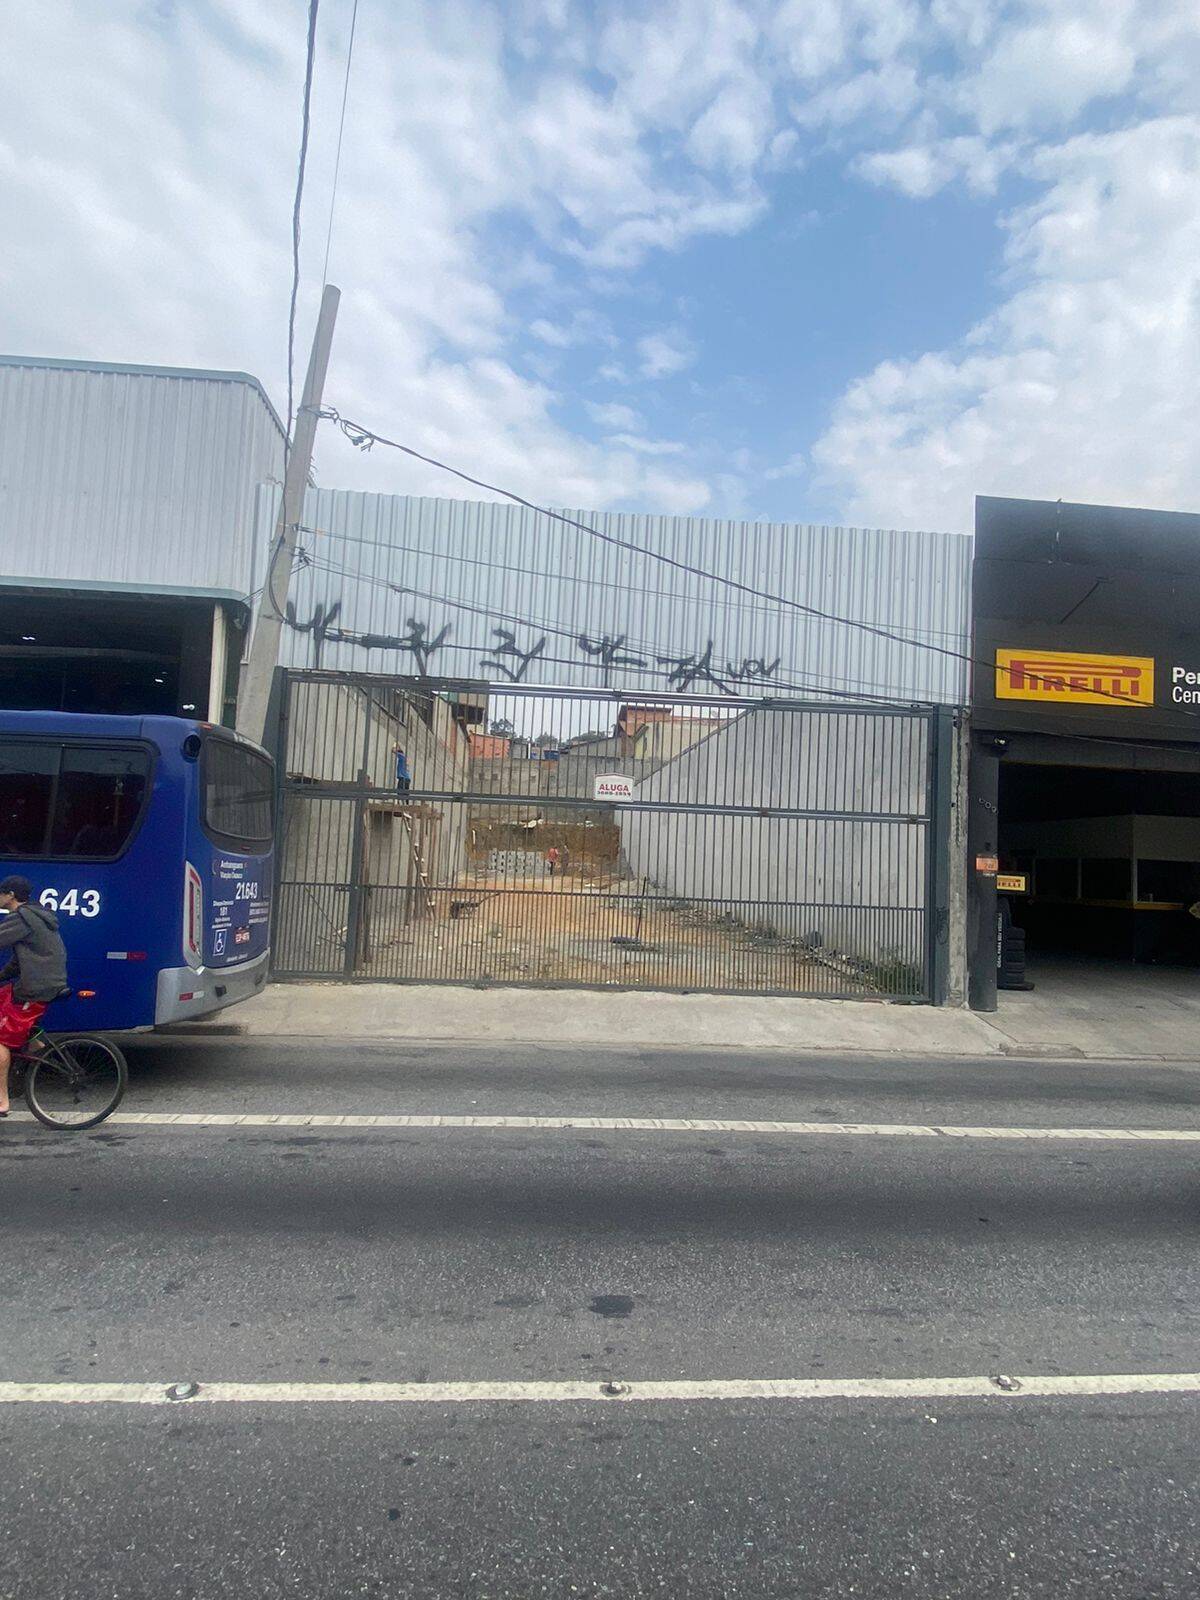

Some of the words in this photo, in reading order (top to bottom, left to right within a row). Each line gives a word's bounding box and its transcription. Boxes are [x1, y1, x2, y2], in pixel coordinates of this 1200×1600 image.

[1009, 659, 1142, 697] PIRELLI
[599, 783, 629, 791] ALUGA
[235, 881, 258, 900] 21.643
